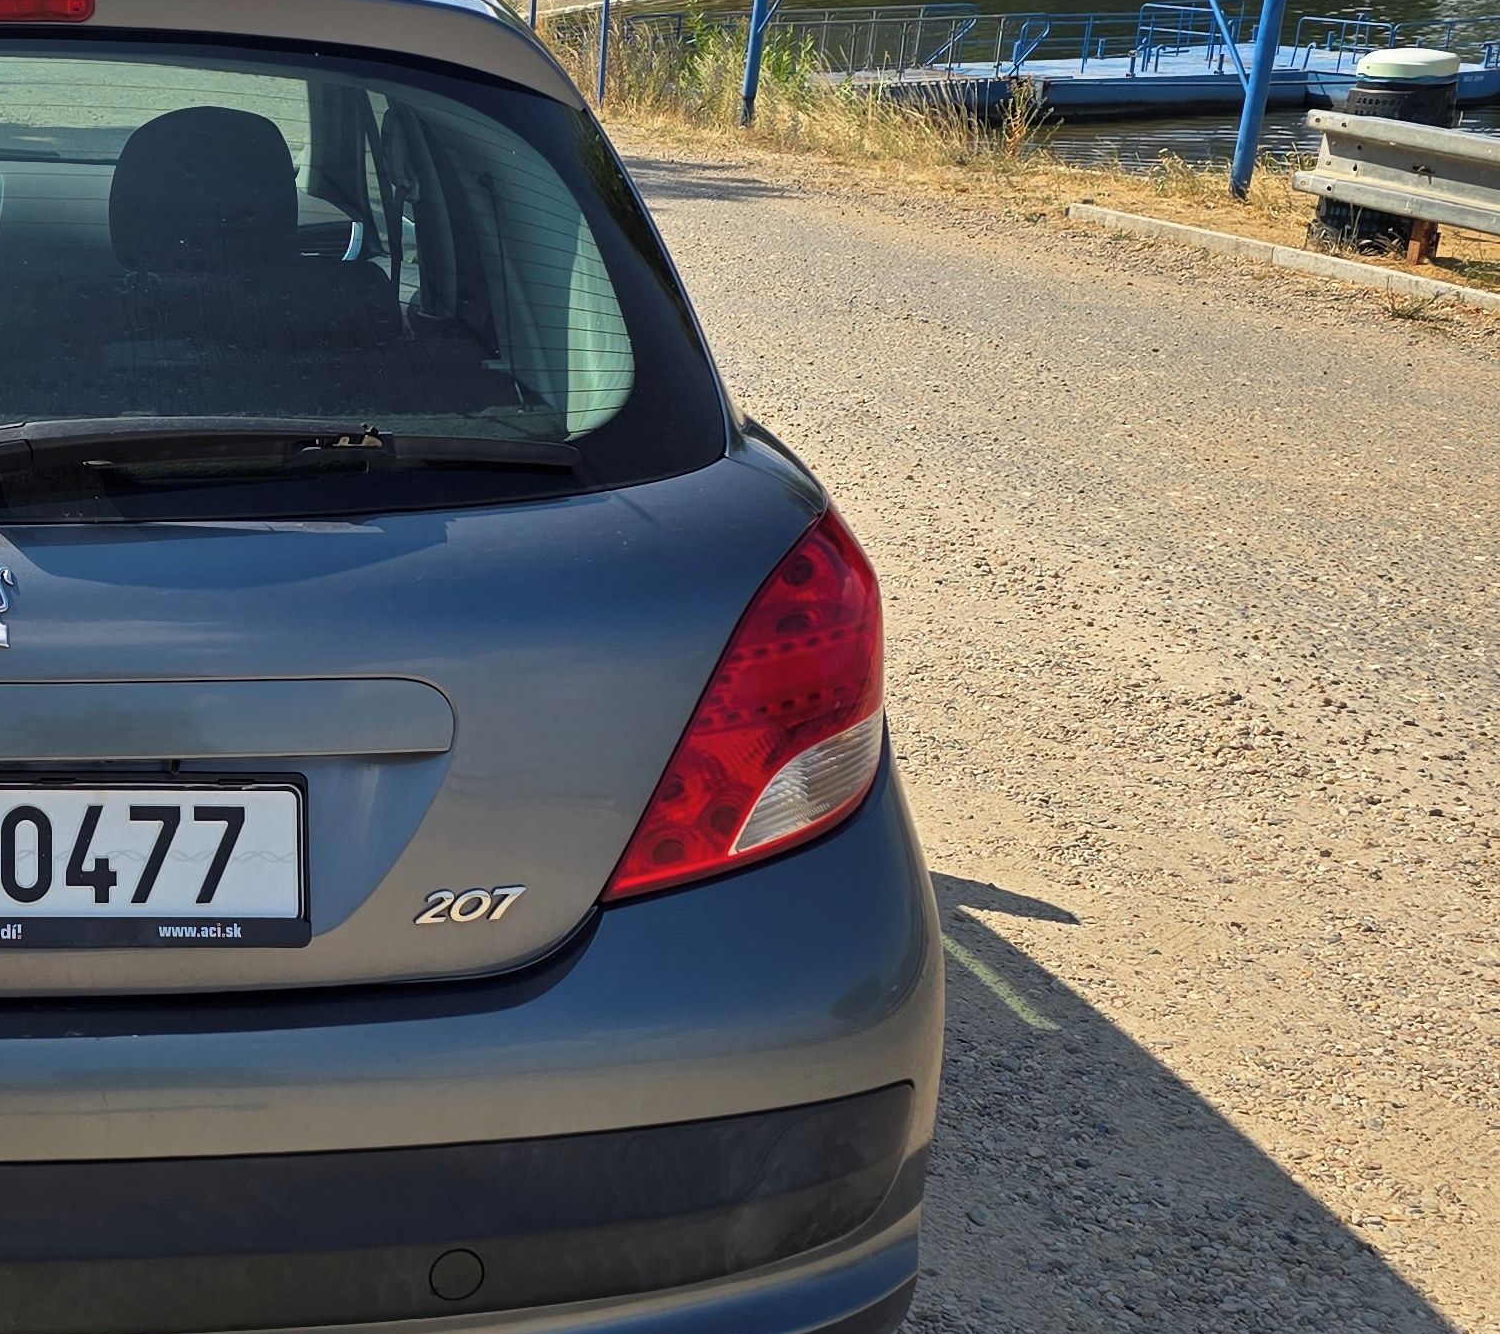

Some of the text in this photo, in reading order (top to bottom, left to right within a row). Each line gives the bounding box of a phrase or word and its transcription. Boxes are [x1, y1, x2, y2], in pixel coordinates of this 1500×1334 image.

[0, 804, 246, 905] 0477
[414, 884, 527, 925] 207
[158, 923, 242, 940] www.aci.sk
